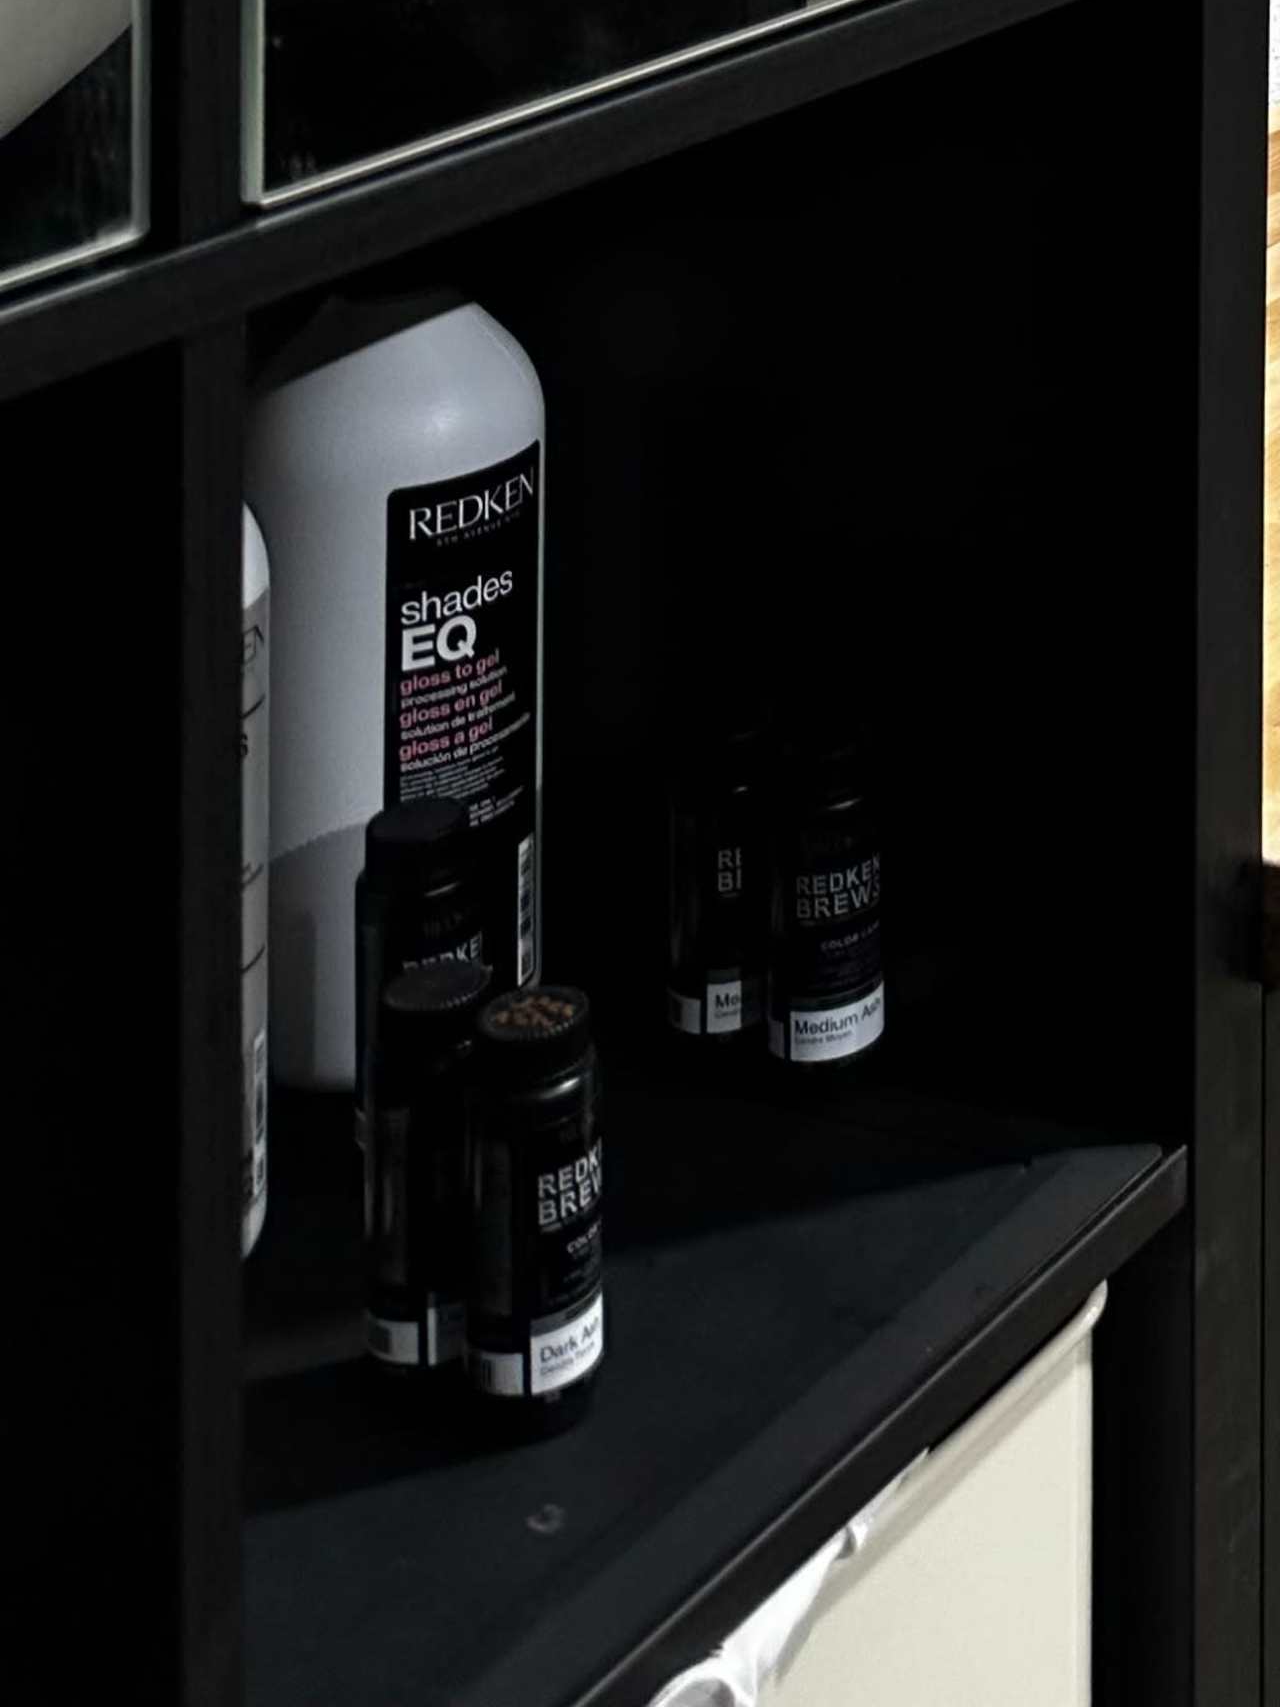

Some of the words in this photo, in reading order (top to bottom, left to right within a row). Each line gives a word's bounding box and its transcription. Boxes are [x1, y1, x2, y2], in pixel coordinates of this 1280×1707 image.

[408, 466, 534, 541] REDKEN
[400, 570, 514, 625] shades
[401, 614, 478, 673] EQ
[400, 671, 451, 697] gloss
[455, 663, 473, 679] to
[476, 648, 500, 675] gel
[400, 683, 468, 709] processing
[399, 703, 451, 729] gloss
[454, 693, 476, 713] en
[479, 678, 503, 707] gel
[399, 735, 450, 762] gloss
[454, 730, 465, 745] a
[468, 714, 494, 743] gel
[401, 719, 450, 741] solution
[794, 1012, 859, 1037] Medium
[540, 1336, 579, 1364] Dark
